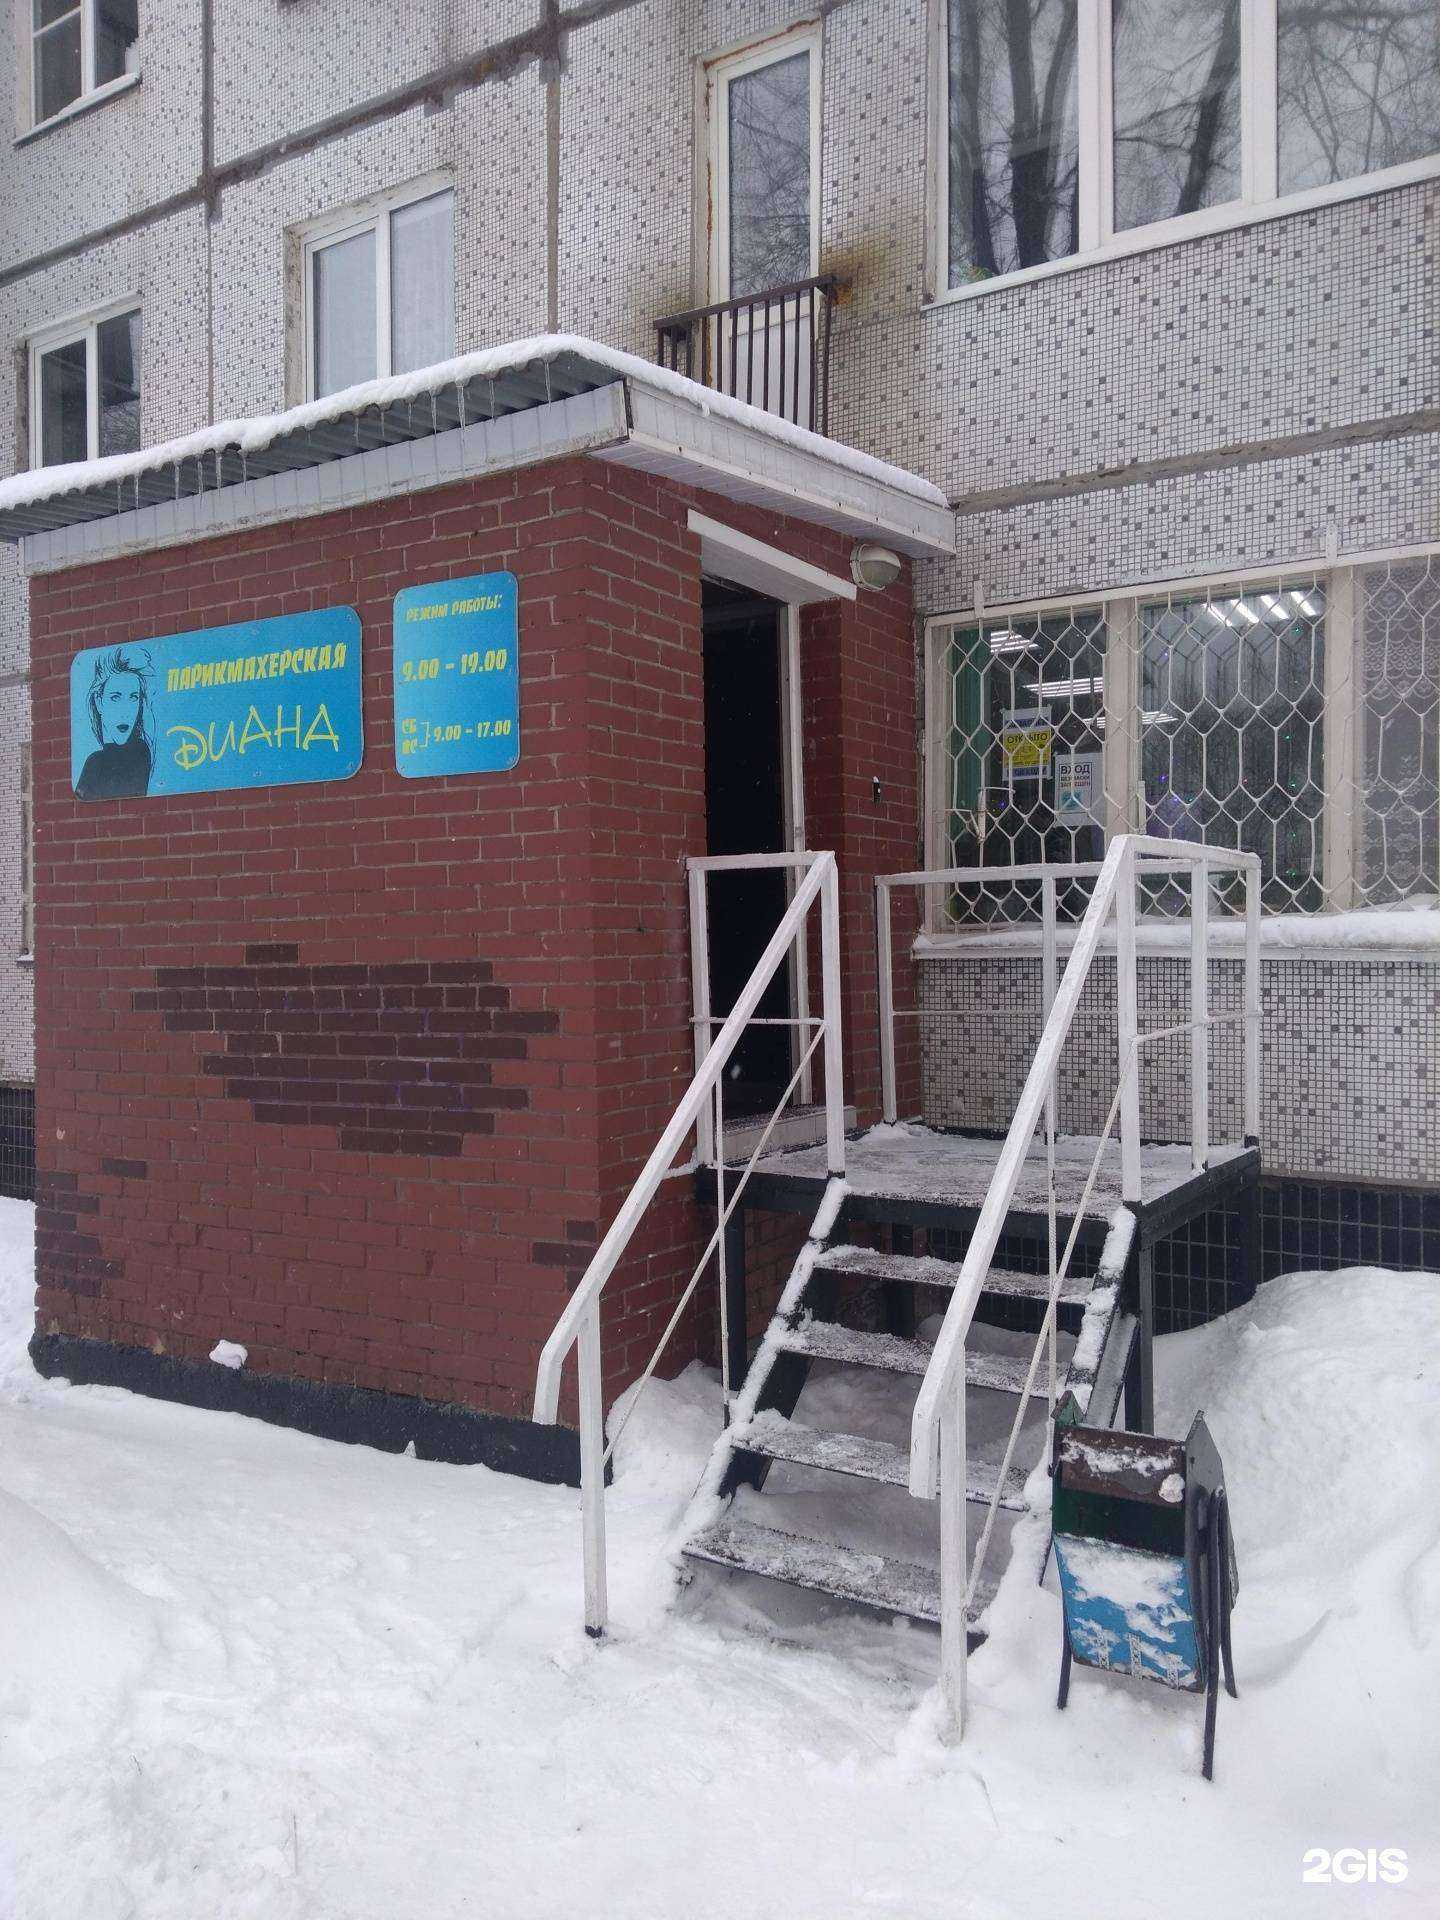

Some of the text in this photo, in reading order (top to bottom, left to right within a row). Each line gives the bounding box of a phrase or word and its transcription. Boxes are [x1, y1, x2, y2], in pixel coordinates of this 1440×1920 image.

[406, 595, 502, 621] РЕЖИМ РАБОТЫ:
[167, 642, 347, 692] ПАРИКМАХЕРСКАЯ
[402, 658, 439, 681] 9.00
[461, 649, 507, 674] 19.00
[167, 703, 339, 770] ДИАНА
[402, 718, 416, 734] СБ
[434, 725, 461, 742] 9.00
[478, 719, 511, 737] 17.00
[1007, 733, 1047, 743] ОТКЫТО
